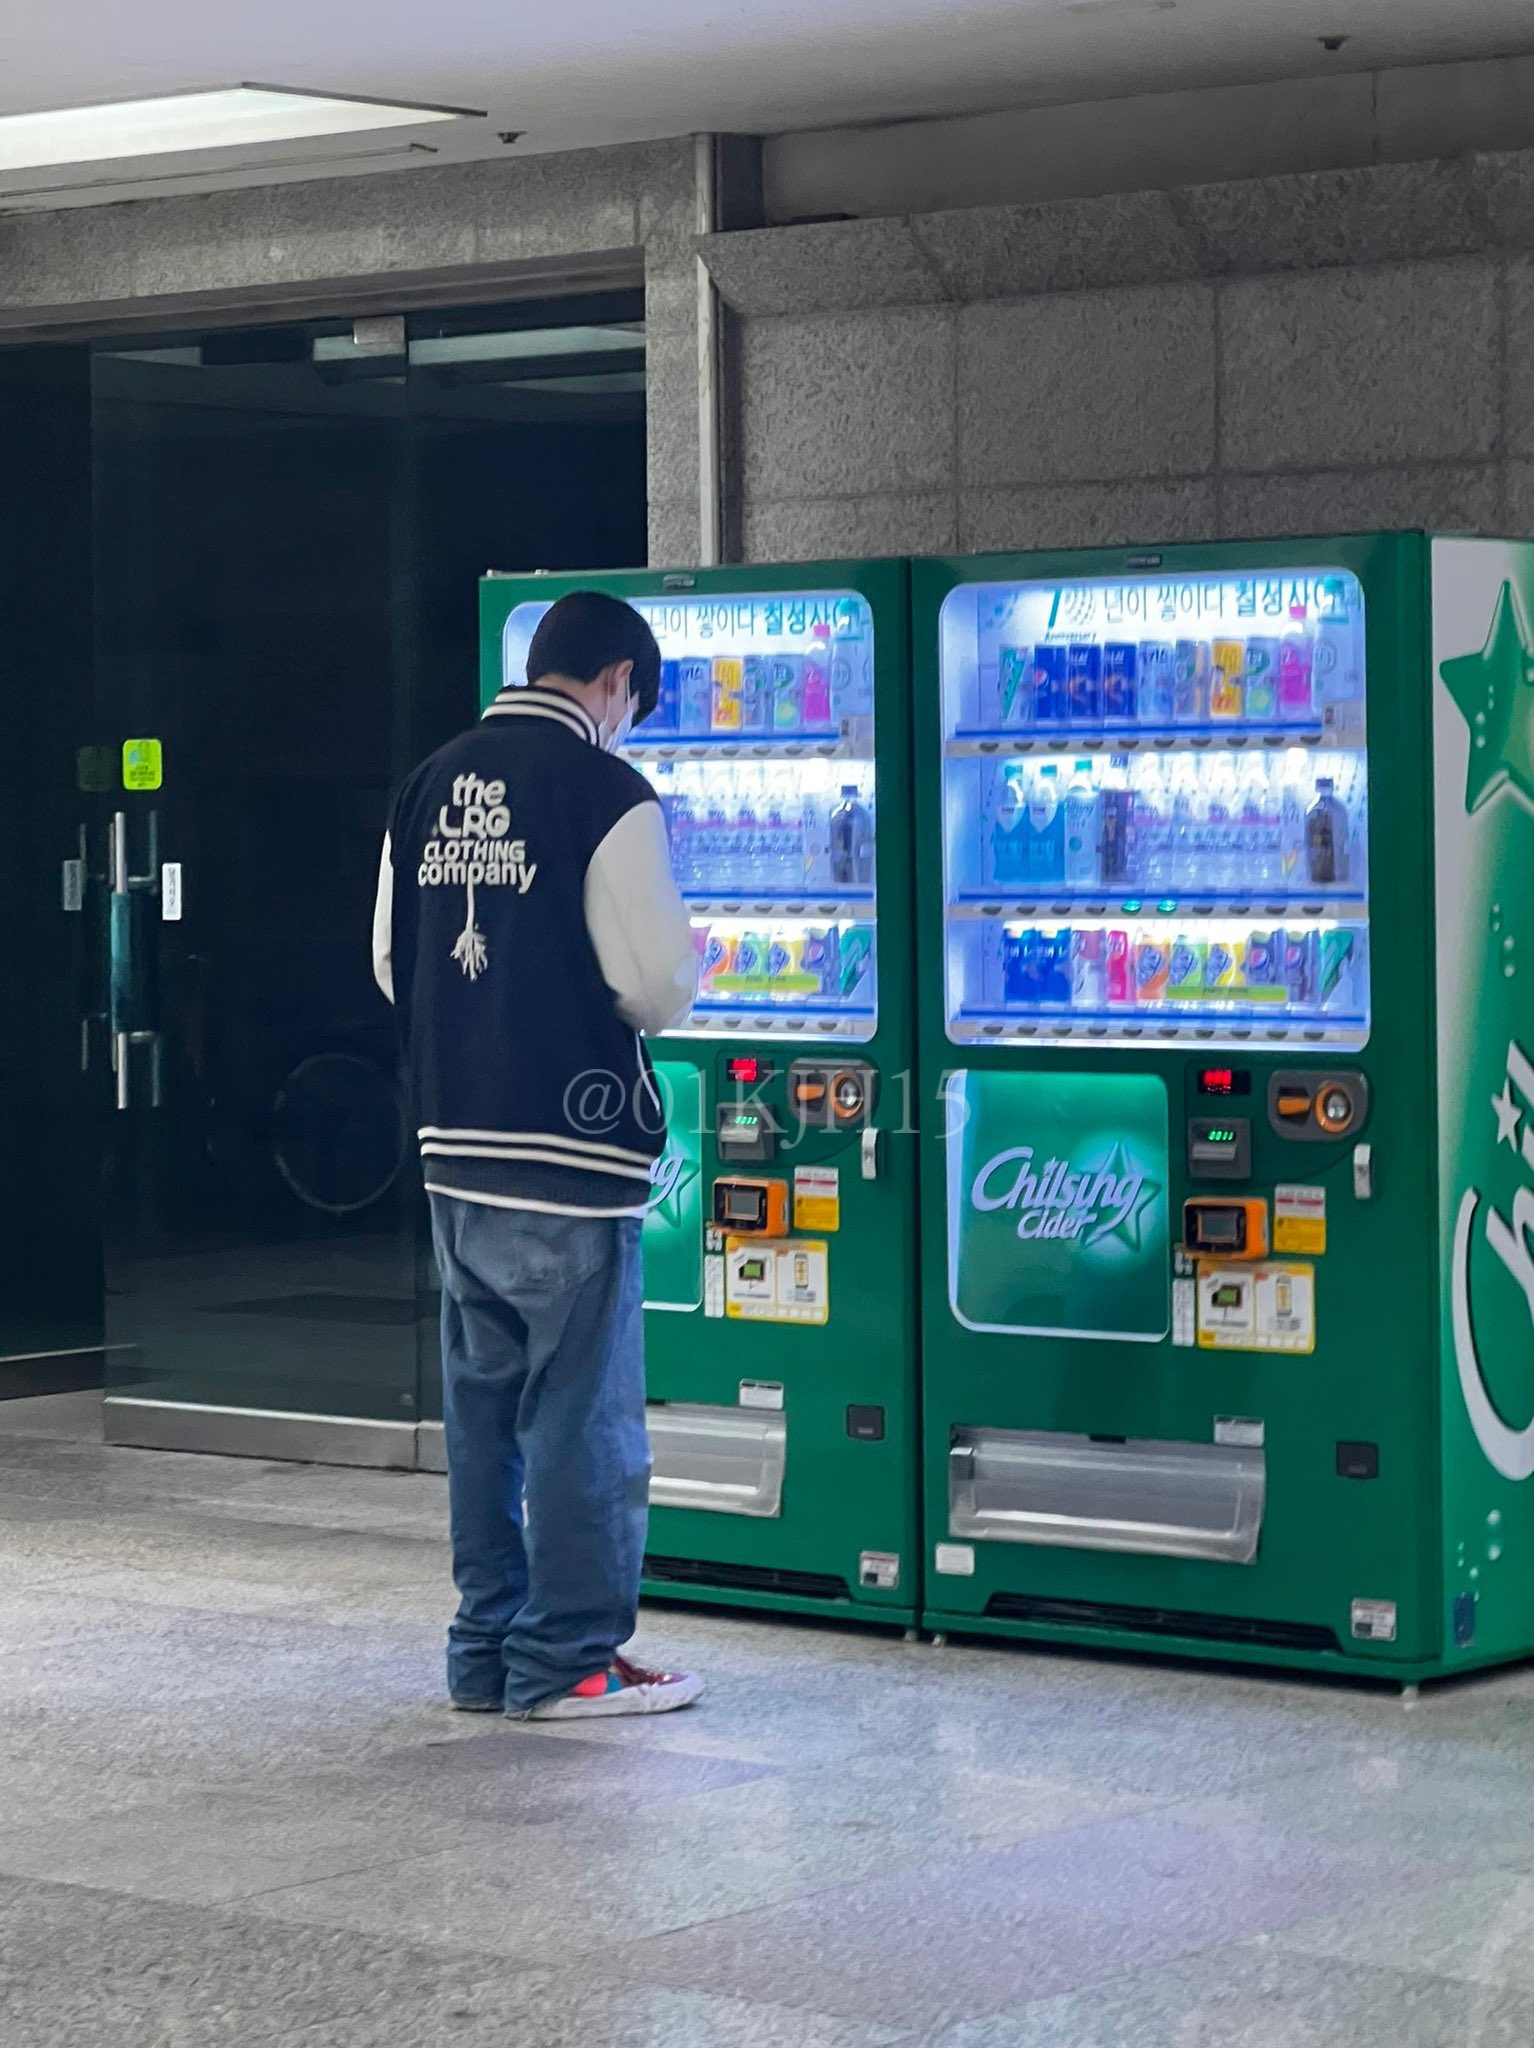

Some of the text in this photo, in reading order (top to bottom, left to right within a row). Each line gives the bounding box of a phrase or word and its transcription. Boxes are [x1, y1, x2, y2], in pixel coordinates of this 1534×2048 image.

[452, 771, 507, 807] the
[438, 804, 512, 839] LRG
[423, 839, 526, 863] CLOTHING
[417, 861, 538, 894] company
[971, 1145, 1144, 1247] Chilsung
[1016, 1209, 1098, 1240] Cider
